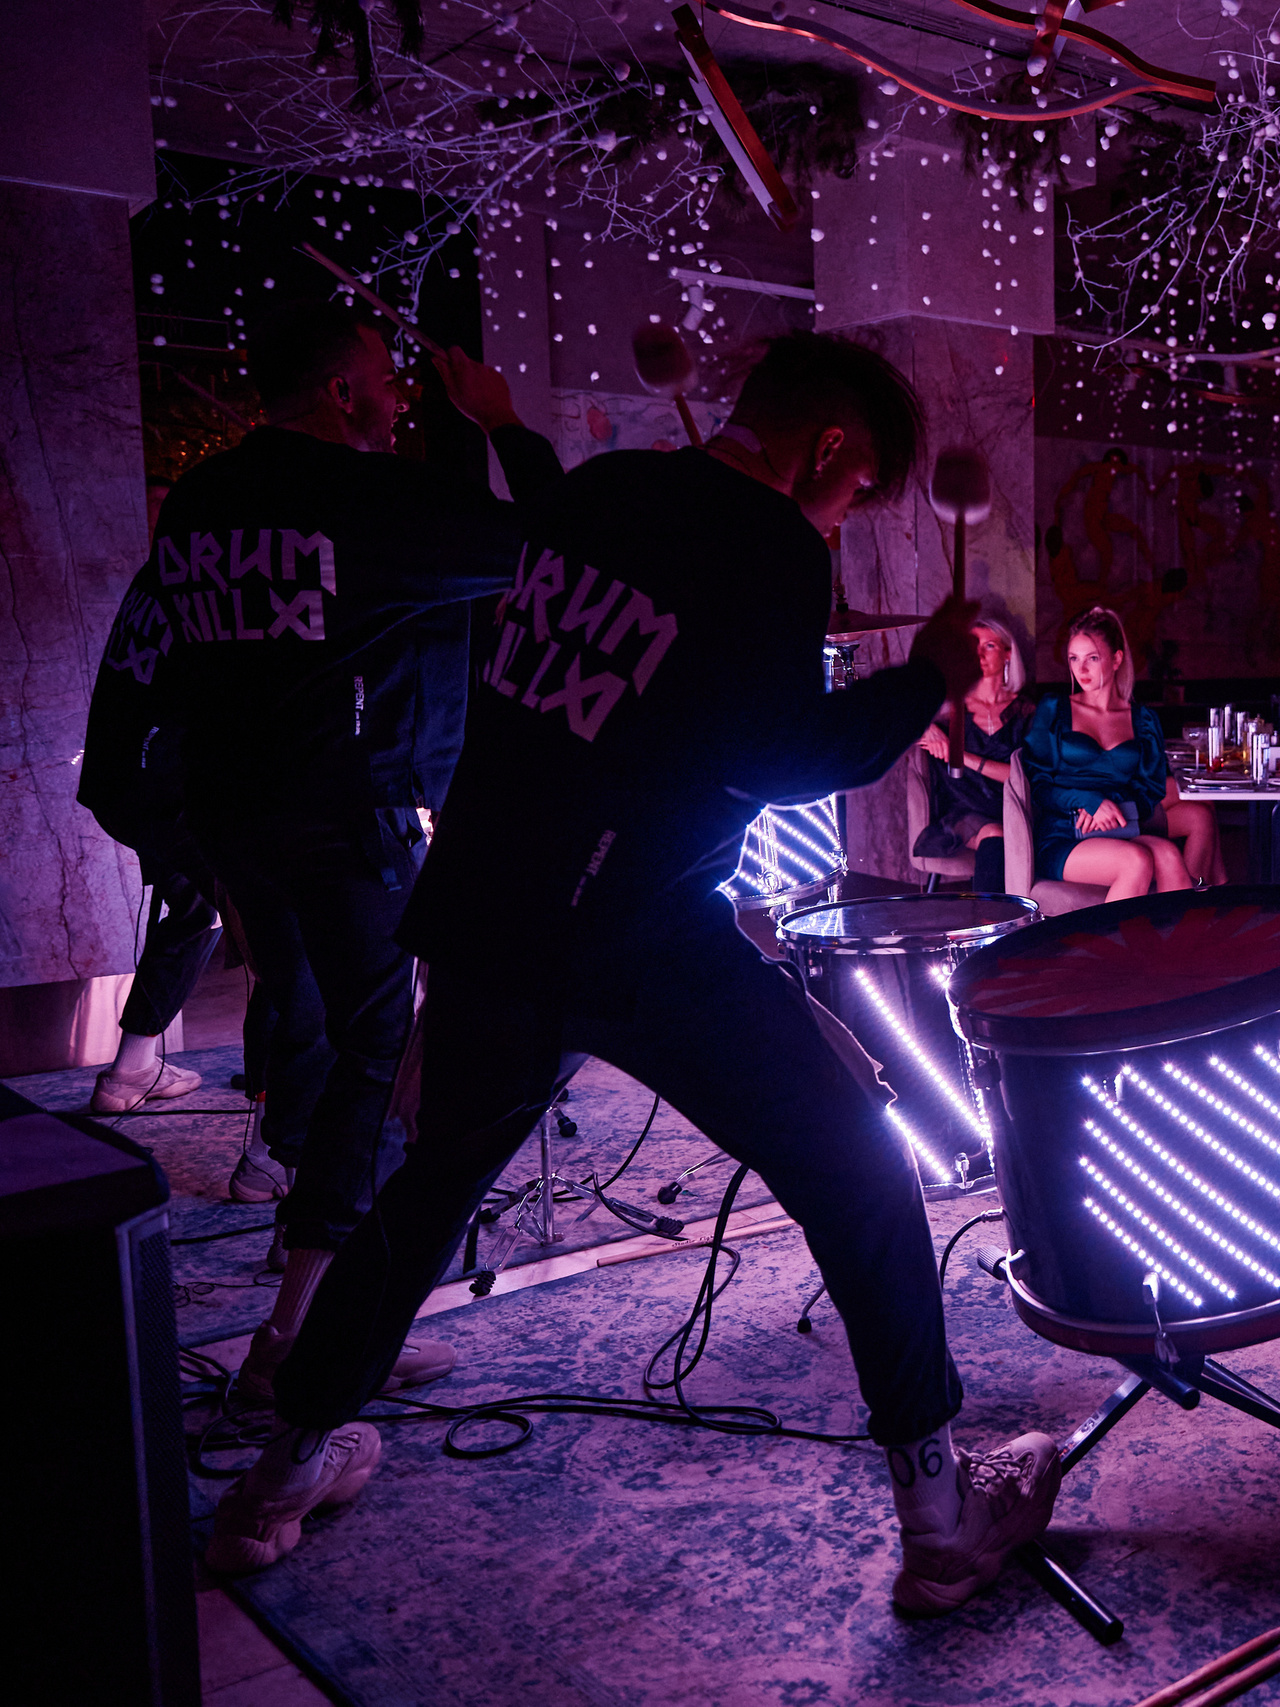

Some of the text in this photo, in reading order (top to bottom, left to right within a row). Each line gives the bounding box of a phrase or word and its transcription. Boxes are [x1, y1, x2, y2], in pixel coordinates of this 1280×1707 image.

[157, 528, 337, 597] DRUM
[118, 587, 175, 657] RUM
[353, 675, 365, 711] REPENT
[888, 1438, 943, 1488] 06
